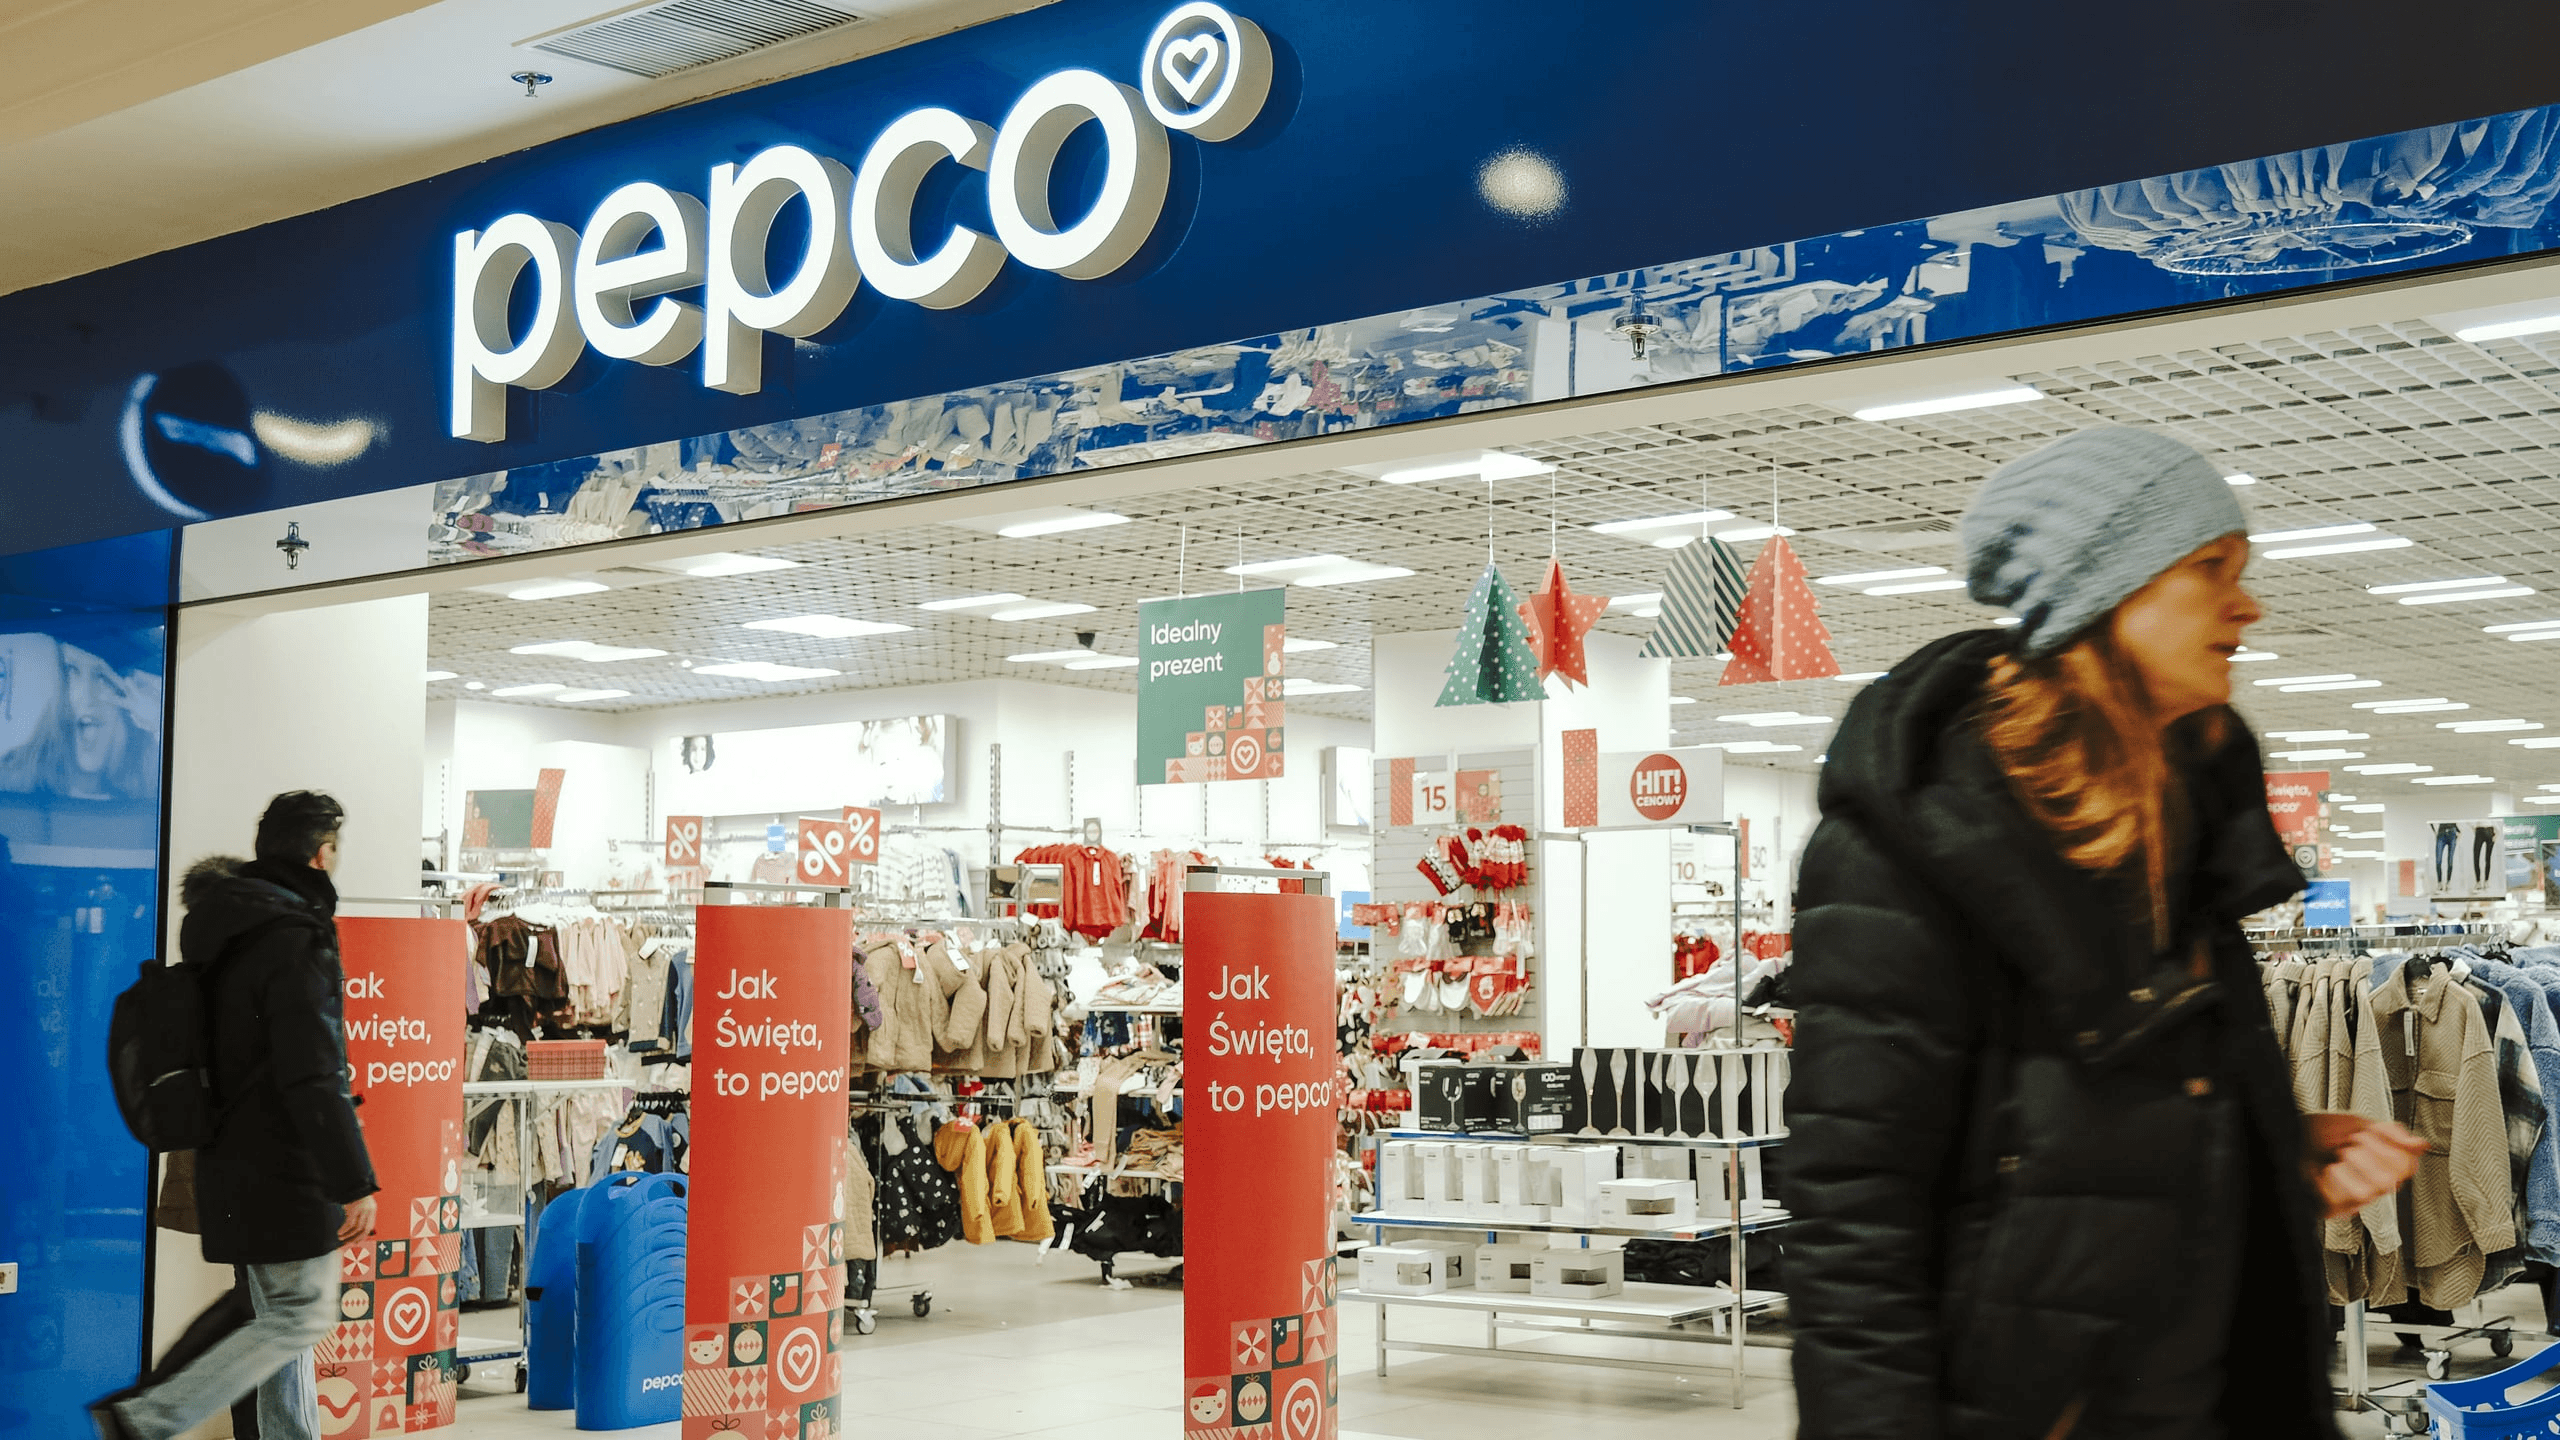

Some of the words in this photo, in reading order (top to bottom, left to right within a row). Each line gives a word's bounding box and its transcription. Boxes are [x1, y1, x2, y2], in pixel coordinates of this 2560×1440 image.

[450, 67, 1160, 443] pepco
[1150, 619, 1222, 645] Idealny
[1150, 652, 1223, 682] prezent
[1635, 769, 1682, 796] HIT!
[1422, 785, 1447, 812] 15
[1636, 795, 1682, 808] CENOWY
[1676, 862, 1696, 880] 10
[343, 971, 385, 999] ak
[716, 968, 778, 1000] Jak
[1208, 965, 1271, 1000] Jak
[345, 1013, 431, 1048] więta,
[715, 1008, 822, 1055] Święta,
[1208, 1011, 1314, 1064] Święta,
[367, 1060, 452, 1089] pepco
[713, 1068, 750, 1097] to
[760, 1068, 841, 1102] pepco
[1207, 1080, 1245, 1112] to
[1256, 1080, 1330, 1118] pepco
